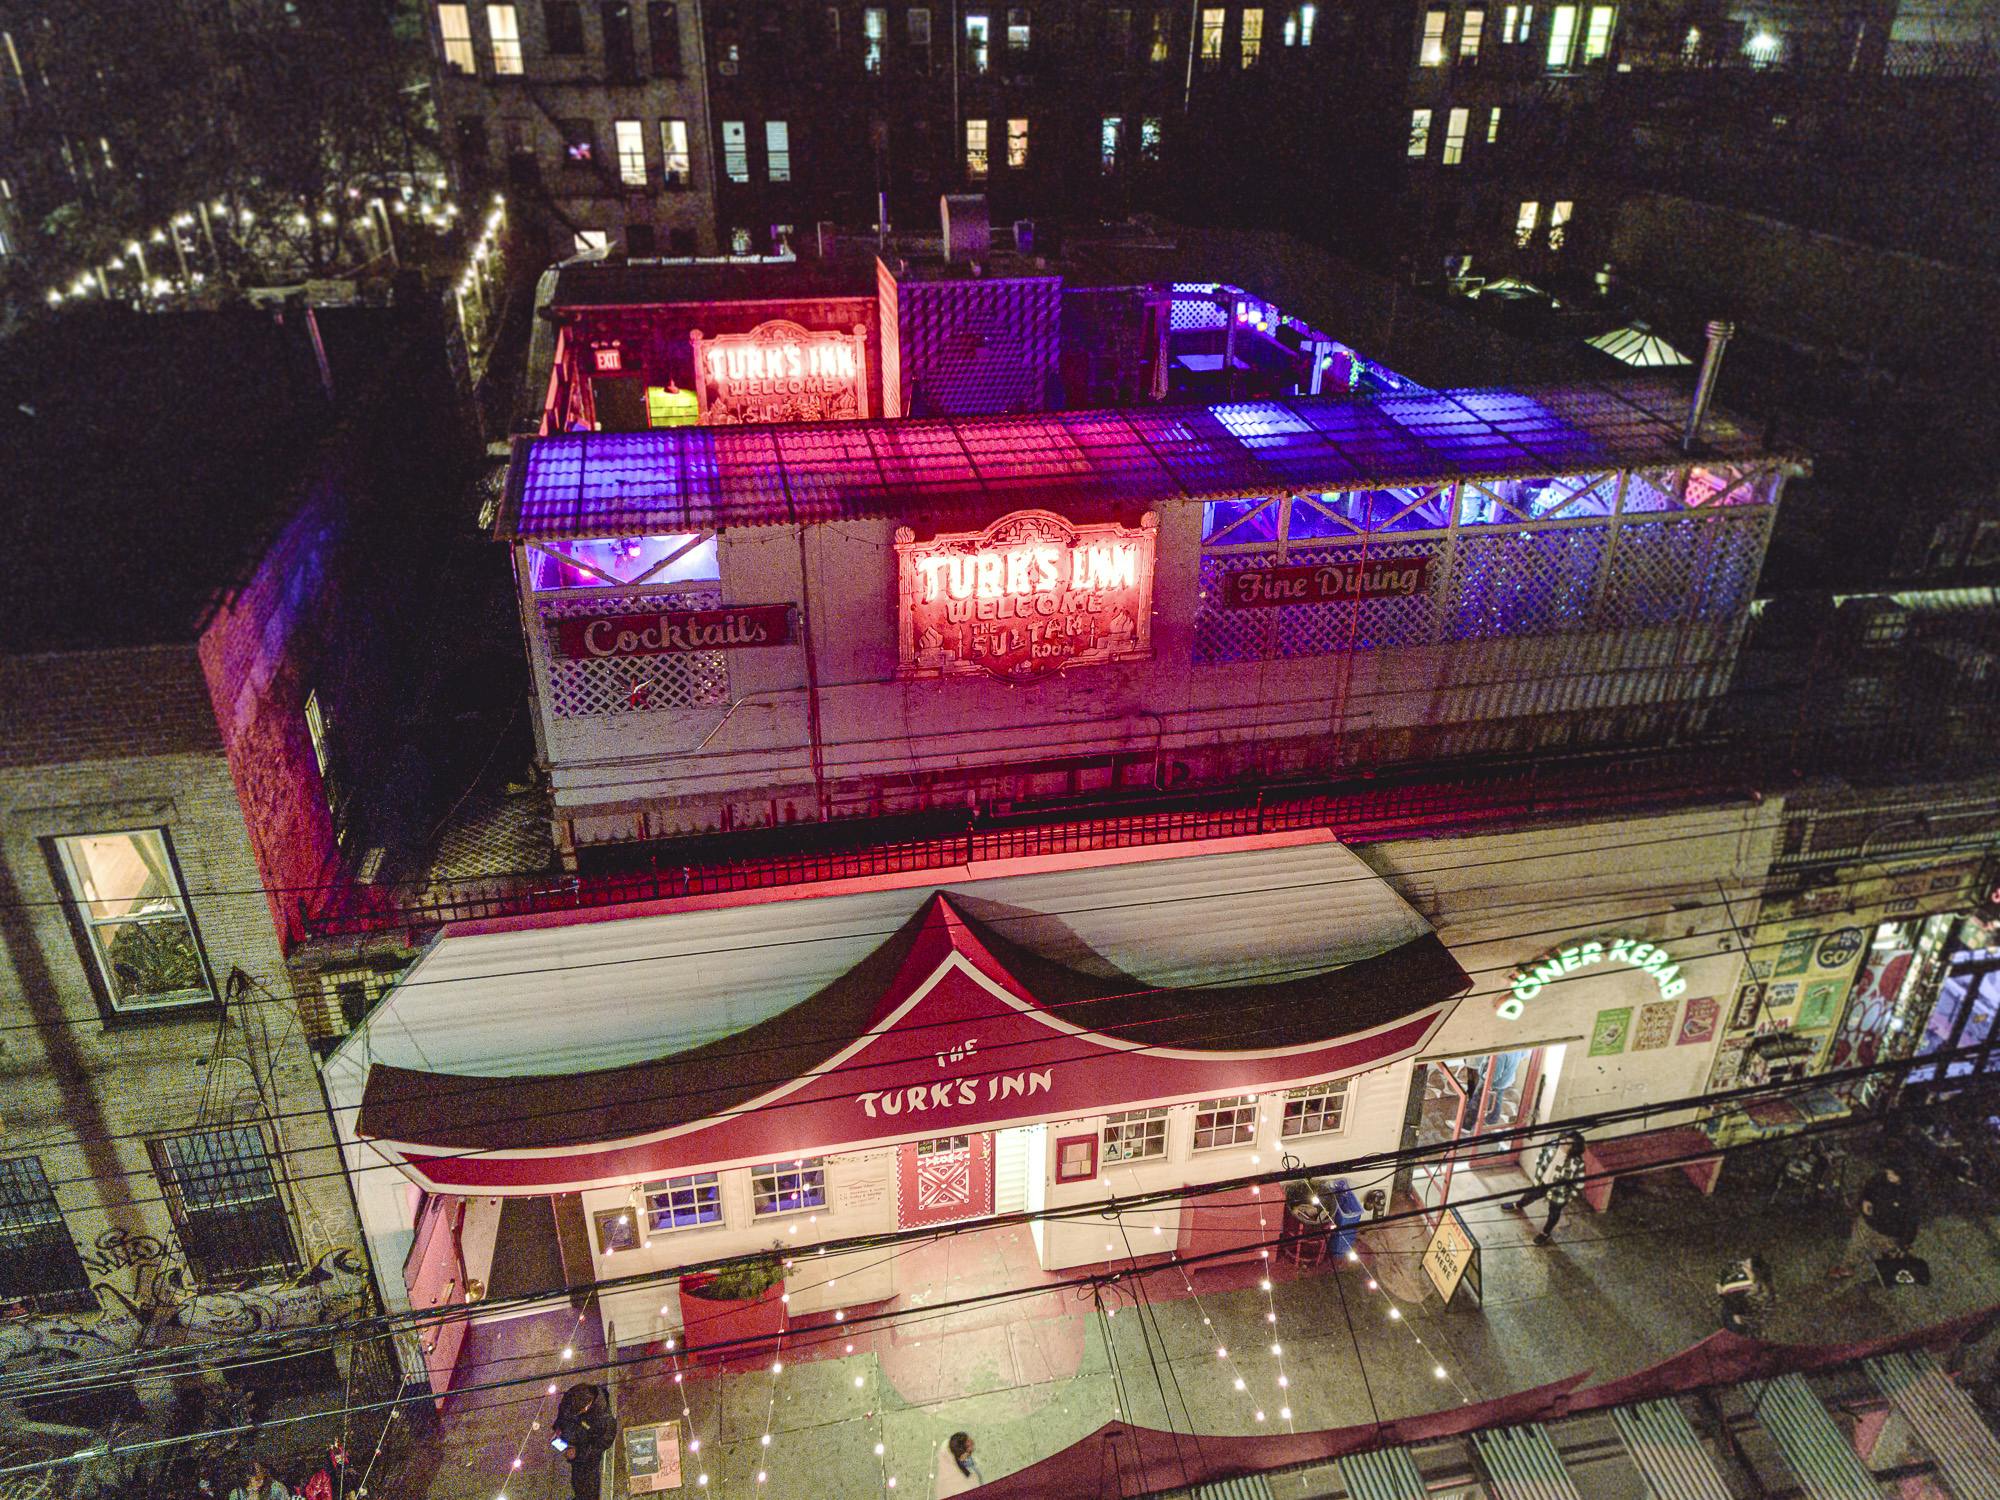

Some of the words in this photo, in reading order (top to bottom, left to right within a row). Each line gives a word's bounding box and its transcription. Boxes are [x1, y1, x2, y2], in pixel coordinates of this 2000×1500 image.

[598, 352, 618, 369] EXIT
[707, 344, 801, 381] TURK'S
[809, 343, 855, 377] INN
[729, 378, 833, 397] WELCOME
[918, 546, 1059, 604] TURK'S
[1071, 543, 1136, 592] INN
[1238, 572, 1307, 602] Fine
[1315, 565, 1418, 595] Dining
[946, 592, 1104, 624] WELCOME
[584, 614, 767, 656] Cocktails
[971, 622, 997, 635] THE
[1031, 642, 1075, 657] ROOM
[1496, 941, 1603, 1021] DÖNER
[1609, 938, 1687, 1000] KEBAB
[1736, 985, 1759, 1027] OPEN
[1757, 1017, 1788, 1034] ATM
[934, 1038, 978, 1068] THE
[856, 1077, 979, 1118] TURK'S
[988, 1068, 1054, 1102] INN
[1107, 1143, 1118, 1155] A
[1435, 1253, 1452, 1281] HERE
[1436, 1240, 1458, 1275] ORDER
